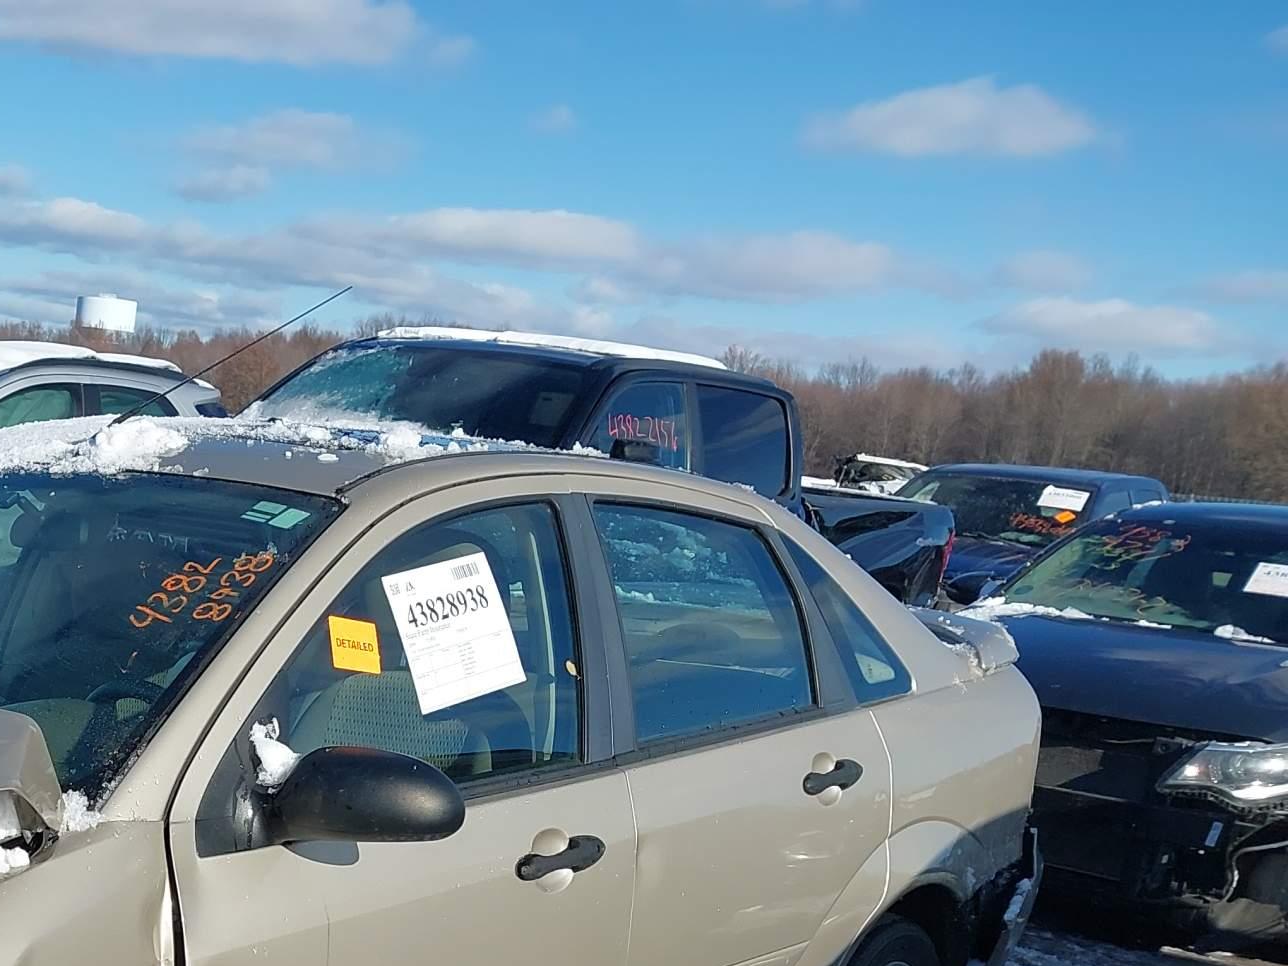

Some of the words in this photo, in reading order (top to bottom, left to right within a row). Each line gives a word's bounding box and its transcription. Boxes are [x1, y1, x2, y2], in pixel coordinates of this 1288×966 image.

[128, 556, 223, 629] 4382
[192, 549, 276, 622] 8938
[407, 584, 489, 628] 43828938
[335, 636, 374, 653] DETAILED
